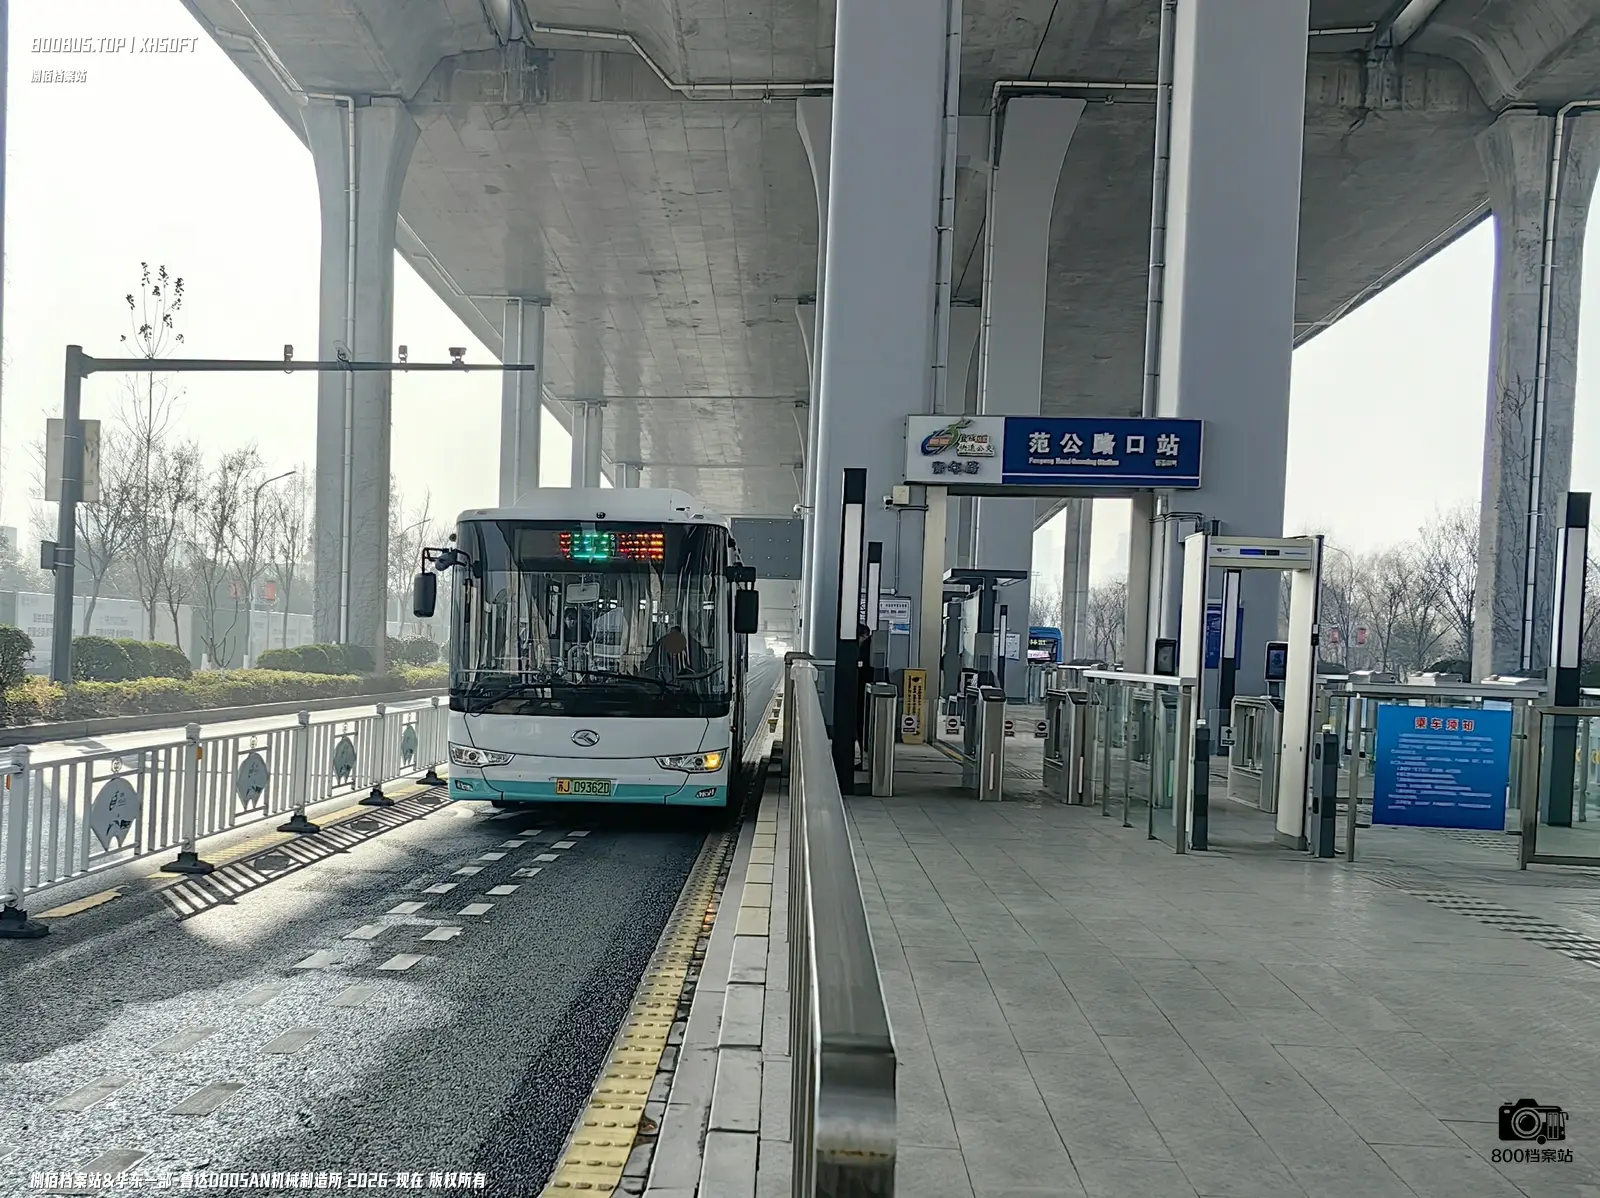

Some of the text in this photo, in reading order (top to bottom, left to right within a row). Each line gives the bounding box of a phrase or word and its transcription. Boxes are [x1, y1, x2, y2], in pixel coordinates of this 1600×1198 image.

[1028, 431, 1181, 456] 范公路口站
